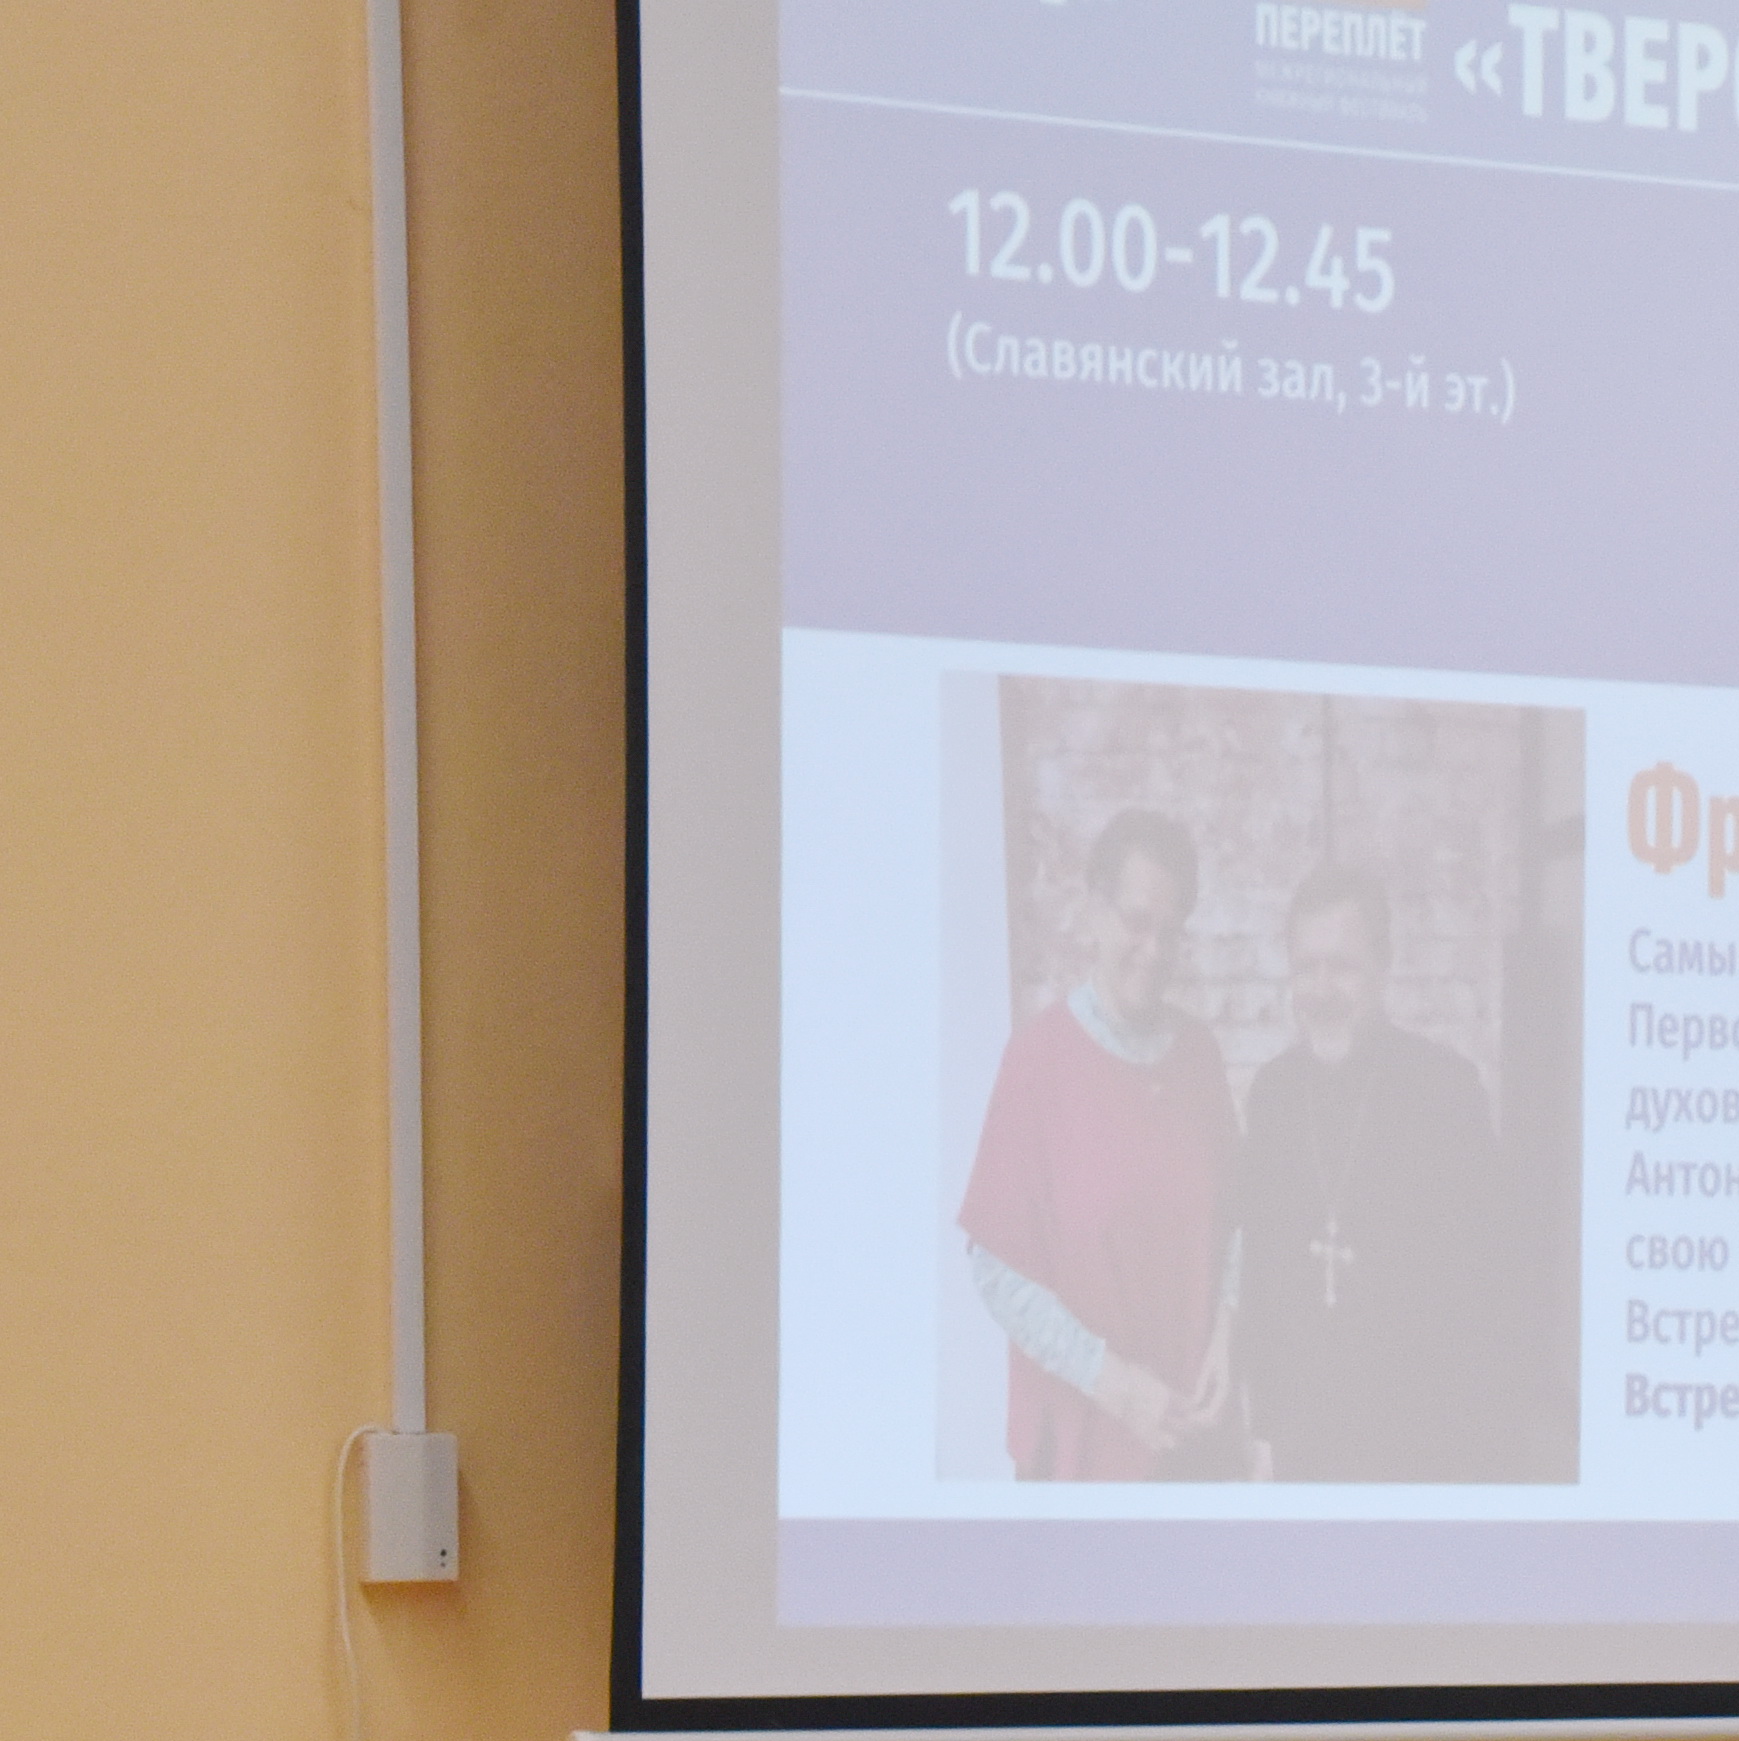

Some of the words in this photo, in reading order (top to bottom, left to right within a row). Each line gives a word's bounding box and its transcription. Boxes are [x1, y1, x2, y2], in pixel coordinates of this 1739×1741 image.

[1256, 4, 1427, 63] ПЕРЕПЛЁТ
[949, 190, 1394, 314] 12.00-12.45
[948, 311, 1242, 394] (Славянский
[1258, 358, 1346, 413] зал,
[1361, 355, 1429, 410] 3-й
[1445, 359, 1516, 425] эт.)
[1626, 1234, 1730, 1271] свою
